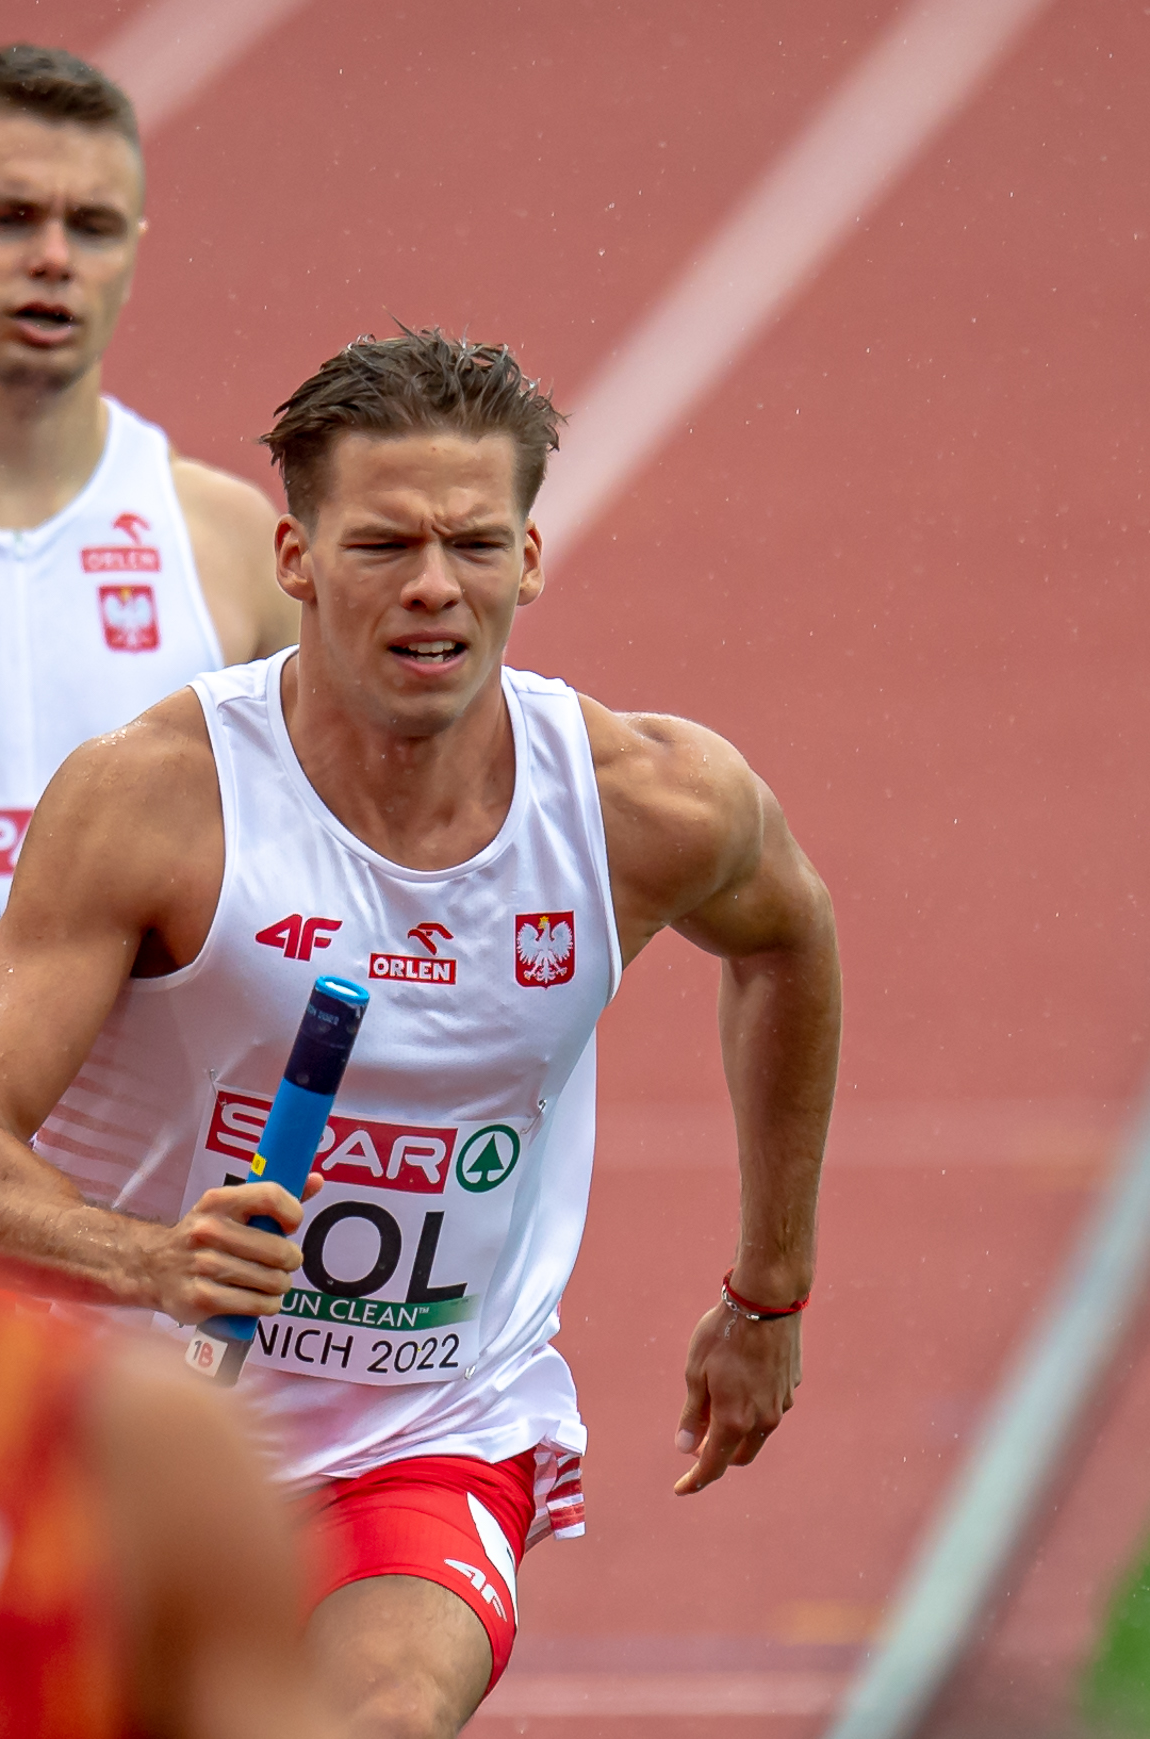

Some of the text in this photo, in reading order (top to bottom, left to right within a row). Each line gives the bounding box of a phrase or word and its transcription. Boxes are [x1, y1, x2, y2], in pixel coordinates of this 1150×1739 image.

[255, 913, 343, 962] 4F
[372, 957, 452, 982] ORLEN
[280, 1292, 322, 1316] UN
[257, 1318, 460, 1374] NICH 2022
[444, 1558, 508, 1623] 4F
